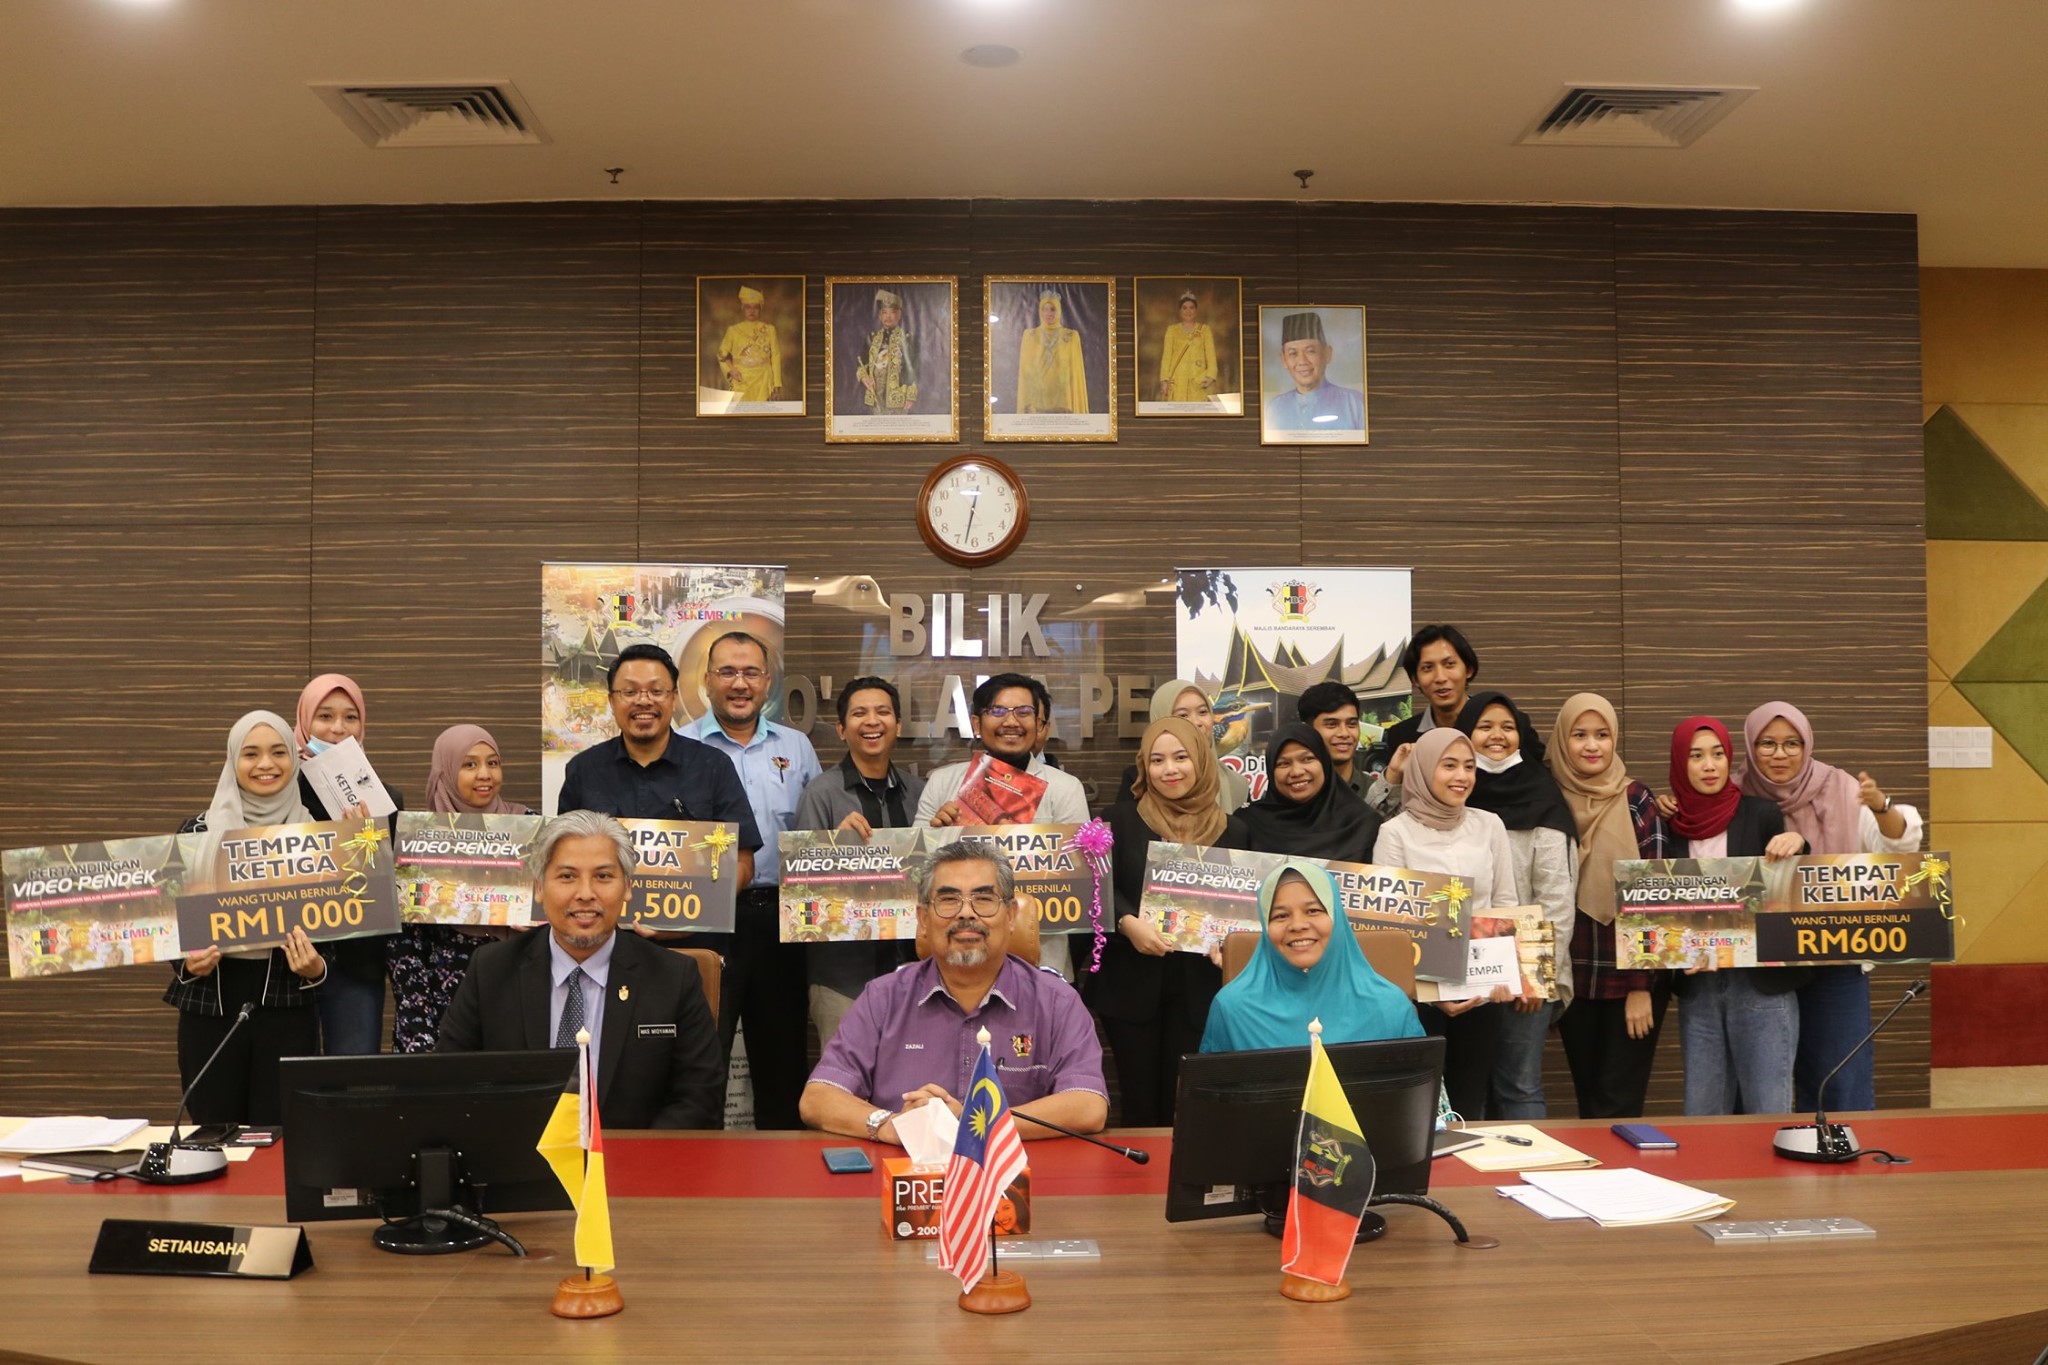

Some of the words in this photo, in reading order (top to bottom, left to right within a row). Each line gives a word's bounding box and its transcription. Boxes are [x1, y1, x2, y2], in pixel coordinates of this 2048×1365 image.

[952, 478, 959, 487] 11
[967, 472, 976, 481] 12
[986, 476, 990, 485] 1
[940, 490, 948, 500] 10
[997, 486, 1005, 496] 2
[935, 506, 942, 516] 9
[1004, 503, 1011, 512] 3
[942, 523, 948, 532] 8
[998, 520, 1006, 530] 4
[954, 534, 961, 544] 7
[971, 538, 978, 548] 6
[988, 532, 994, 542] 5
[890, 593, 1050, 657] BILIK
[416, 830, 511, 841] PERTANDINGAN
[224, 833, 336, 859] TEMPAT
[401, 840, 450, 853] VIDEO
[454, 842, 523, 856] PENDEK
[800, 846, 891, 858] PERTANDINGAN
[30, 859, 141, 880] PERTANDINGAN
[230, 855, 337, 881] KETIGA
[785, 859, 833, 872] VIDEO
[837, 857, 904, 871] PENDEK
[1166, 860, 1255, 877] PERTANDINGAN
[1151, 869, 1197, 884] VIDEO
[1799, 865, 1900, 883] TEMPAT
[13, 877, 72, 898] VIDEO
[78, 869, 157, 891] PENDEK
[645, 880, 692, 890] BERNILAI
[1636, 876, 1727, 887] PERTANDINGAN
[1026, 884, 1071, 894] BERNILAI
[1622, 888, 1671, 901] VIDEO
[1675, 886, 1740, 900] PENDEK
[1803, 886, 1900, 903] KELIMA
[218, 894, 258, 907] WANG
[260, 890, 297, 903] TUNAI
[301, 885, 350, 899] BERNILAI
[1791, 916, 1827, 926] WANG
[1828, 915, 1862, 925] TUNAI
[1864, 914, 1910, 924] BERNILAI
[1797, 928, 1907, 955] RM600
[148, 1239, 248, 1256] SETIAUSAHA
